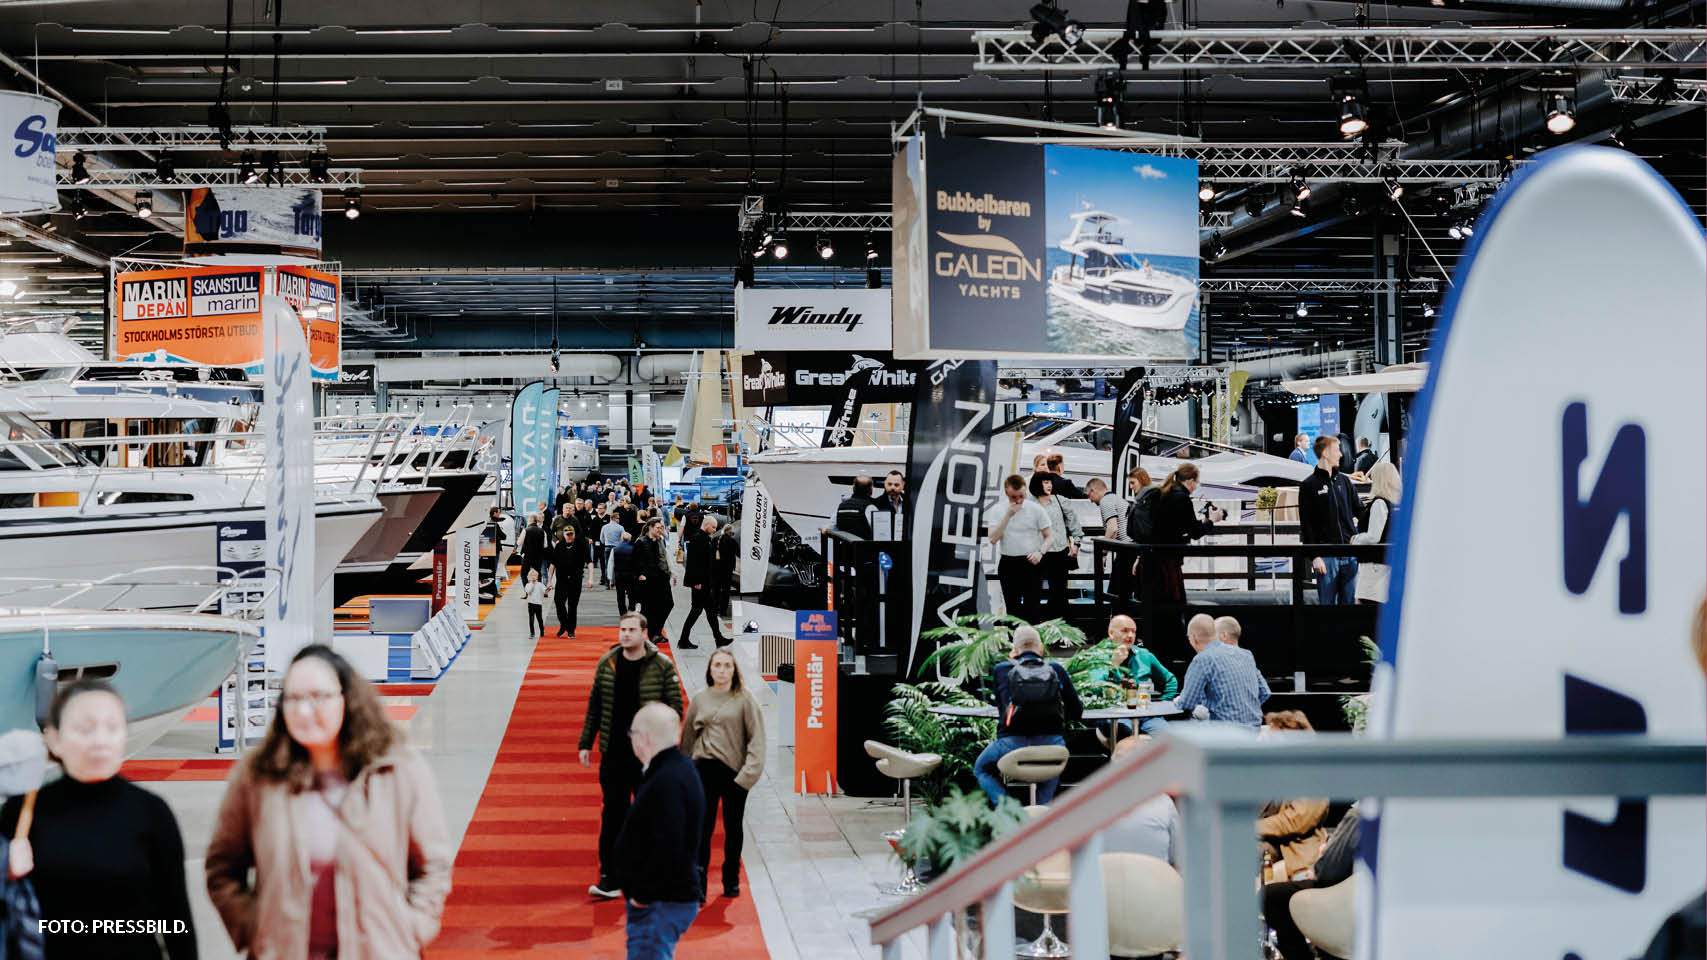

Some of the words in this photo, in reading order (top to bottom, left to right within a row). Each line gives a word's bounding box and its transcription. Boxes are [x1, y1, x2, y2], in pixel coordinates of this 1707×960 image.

[936, 190, 1031, 217] Bubbelbaren
[977, 215, 992, 233] by
[935, 252, 1042, 282] GALEON
[125, 280, 186, 303] MARIN
[193, 274, 258, 295] SKANSTULL
[280, 272, 307, 298] MARIN
[959, 283, 1021, 299] YACHTS
[137, 302, 186, 318] DEPÅN
[207, 295, 257, 313] marin
[767, 306, 864, 332] Windy
[124, 328, 183, 343] STOCKHOLMS
[184, 325, 225, 340] STÖRSTA
[753, 490, 763, 545] MERCURY
[807, 653, 824, 729] Premiär
